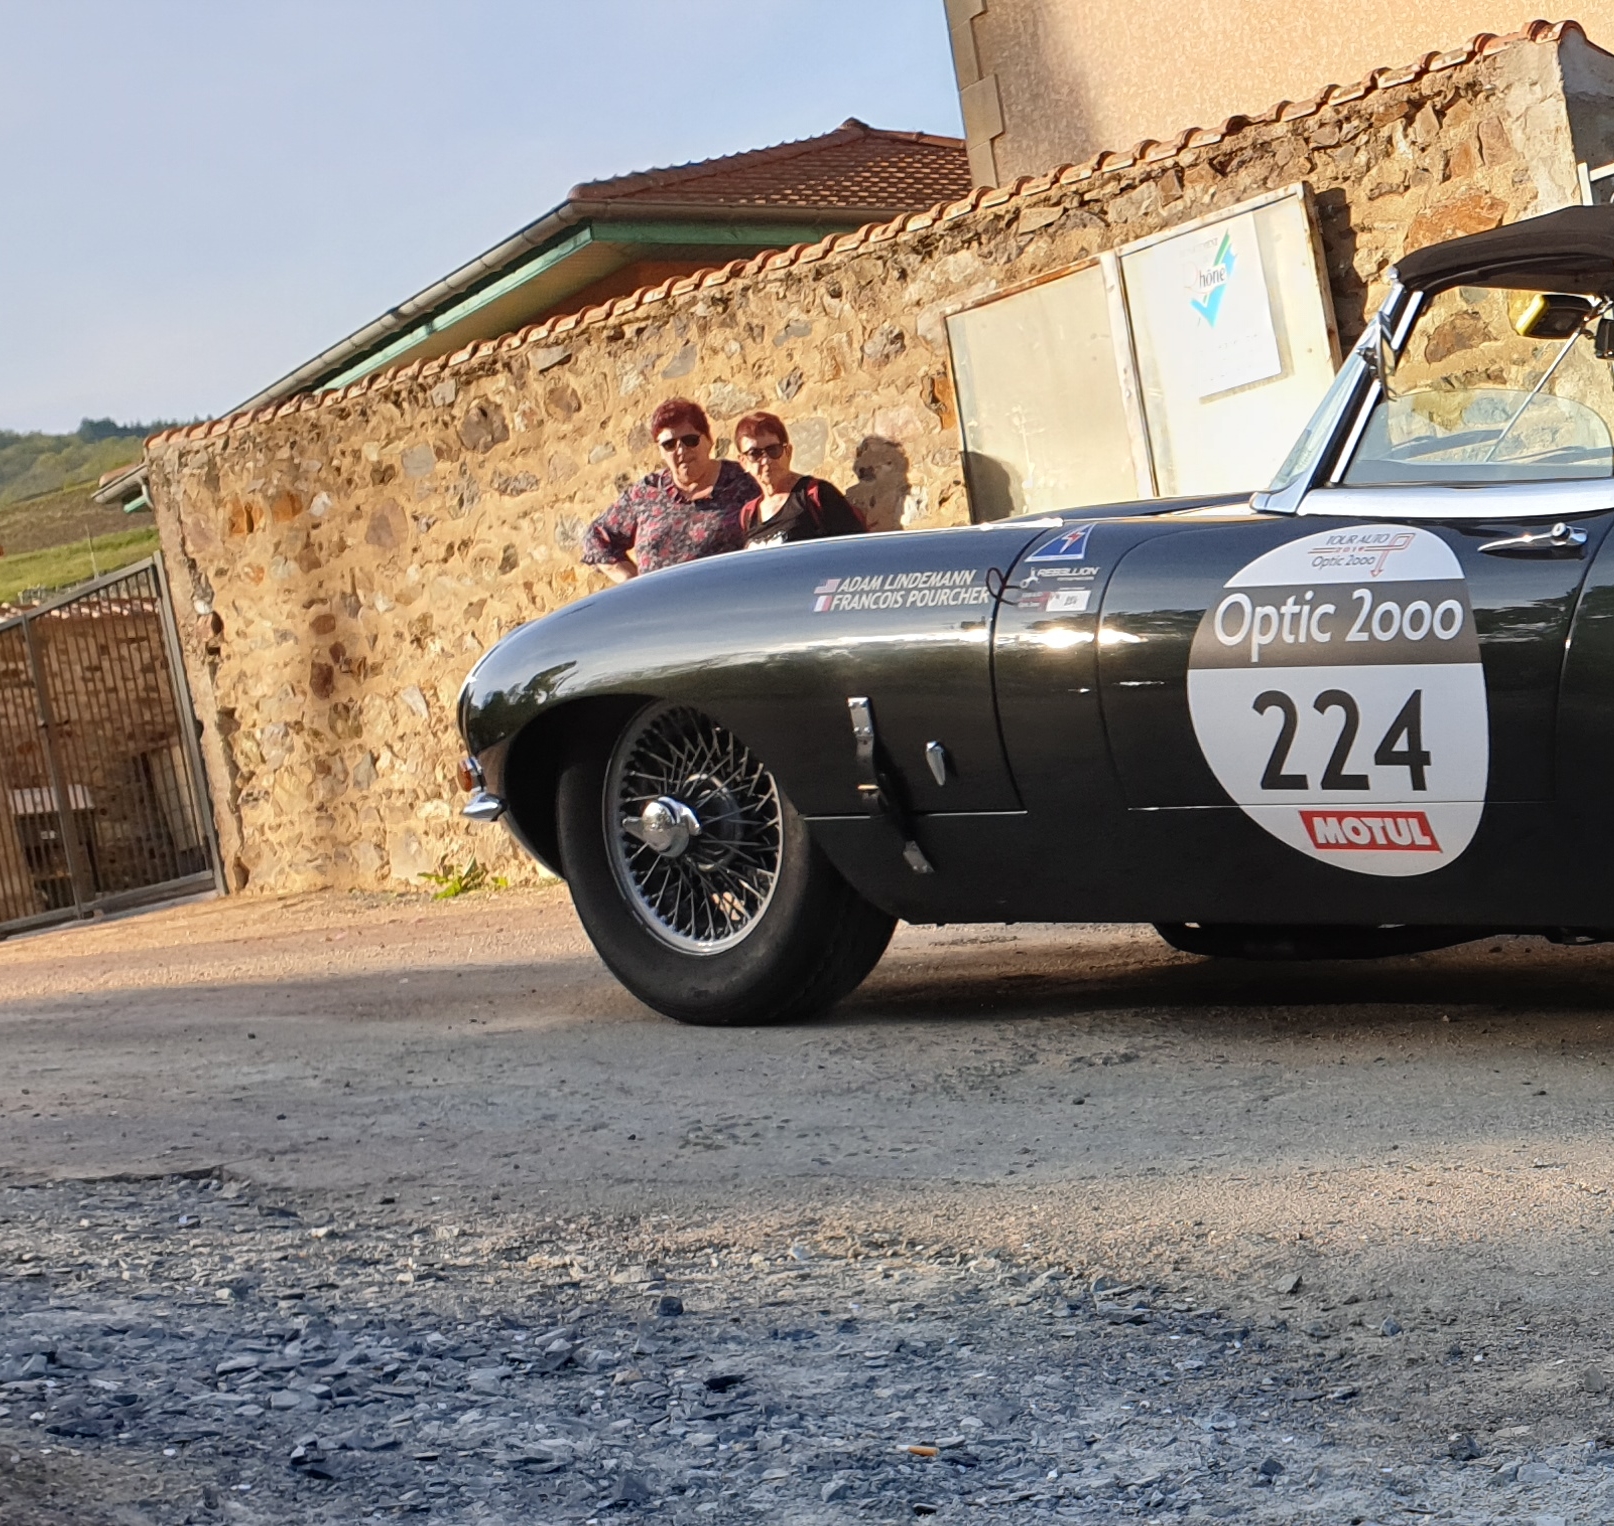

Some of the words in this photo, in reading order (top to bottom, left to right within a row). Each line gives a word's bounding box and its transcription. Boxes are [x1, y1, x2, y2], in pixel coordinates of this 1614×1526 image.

[1326, 534, 1358, 546] TOUR
[1359, 533, 1390, 544] AUTO
[1037, 567, 1100, 577] REBELLION
[1311, 554, 1344, 570] Optic
[837, 575, 882, 593] ADAM
[883, 569, 977, 590] LINDEMANN
[830, 590, 903, 612] FRANCOIS
[905, 586, 990, 608] POURCHER
[1214, 590, 1337, 663] Optic
[1251, 688, 1432, 791] 224
[1312, 816, 1432, 846] MOTUL
